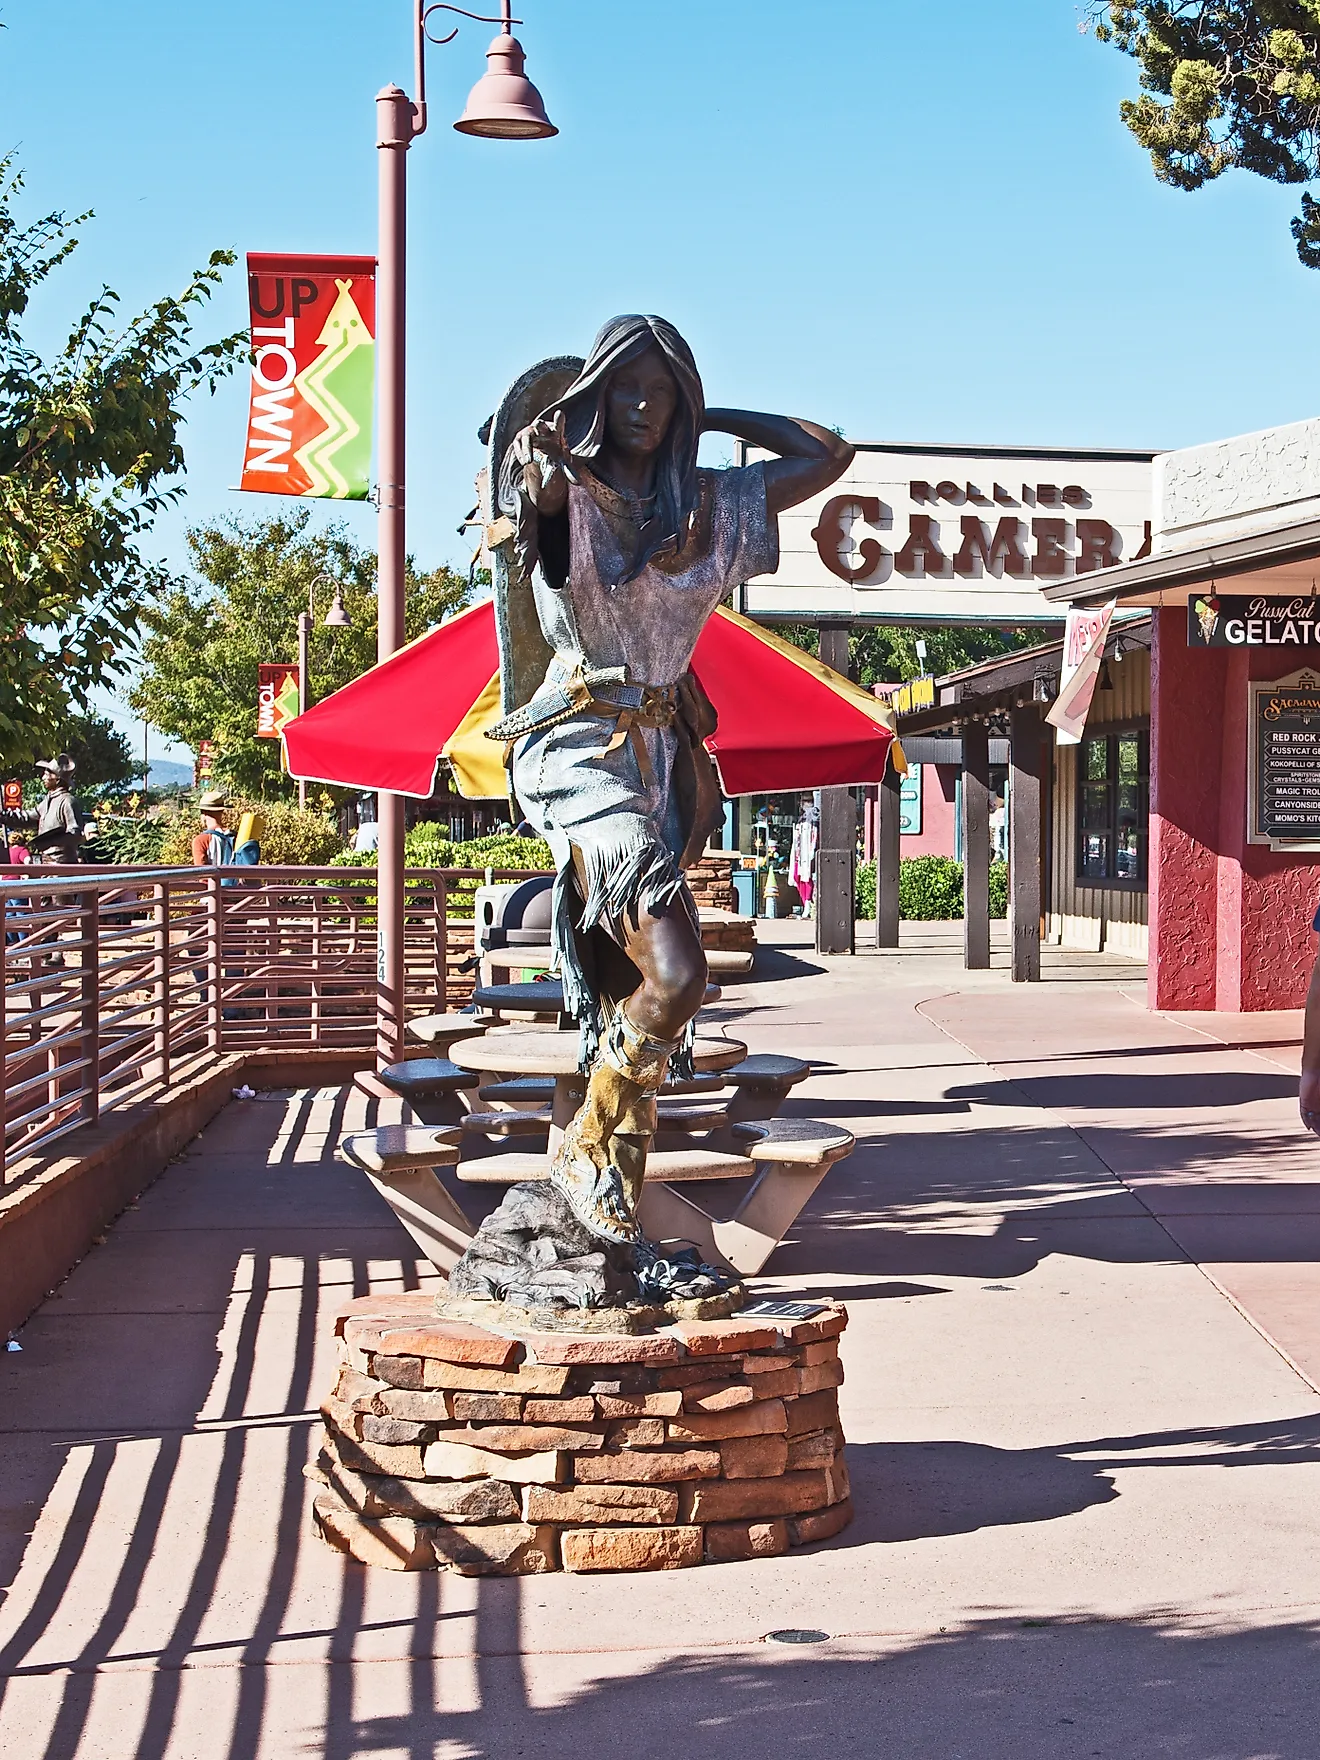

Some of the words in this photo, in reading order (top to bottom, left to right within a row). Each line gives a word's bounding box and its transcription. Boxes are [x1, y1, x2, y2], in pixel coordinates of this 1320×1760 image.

[251, 278, 318, 319] UP
[246, 317, 297, 473] TOWN
[909, 480, 1084, 504] ROLLIES
[1244, 597, 1316, 623] PussyCat
[259, 682, 275, 732] TOWN
[1272, 733, 1290, 741] RED
[1292, 734, 1316, 742] ROCK
[378, 931, 386, 981] 124
